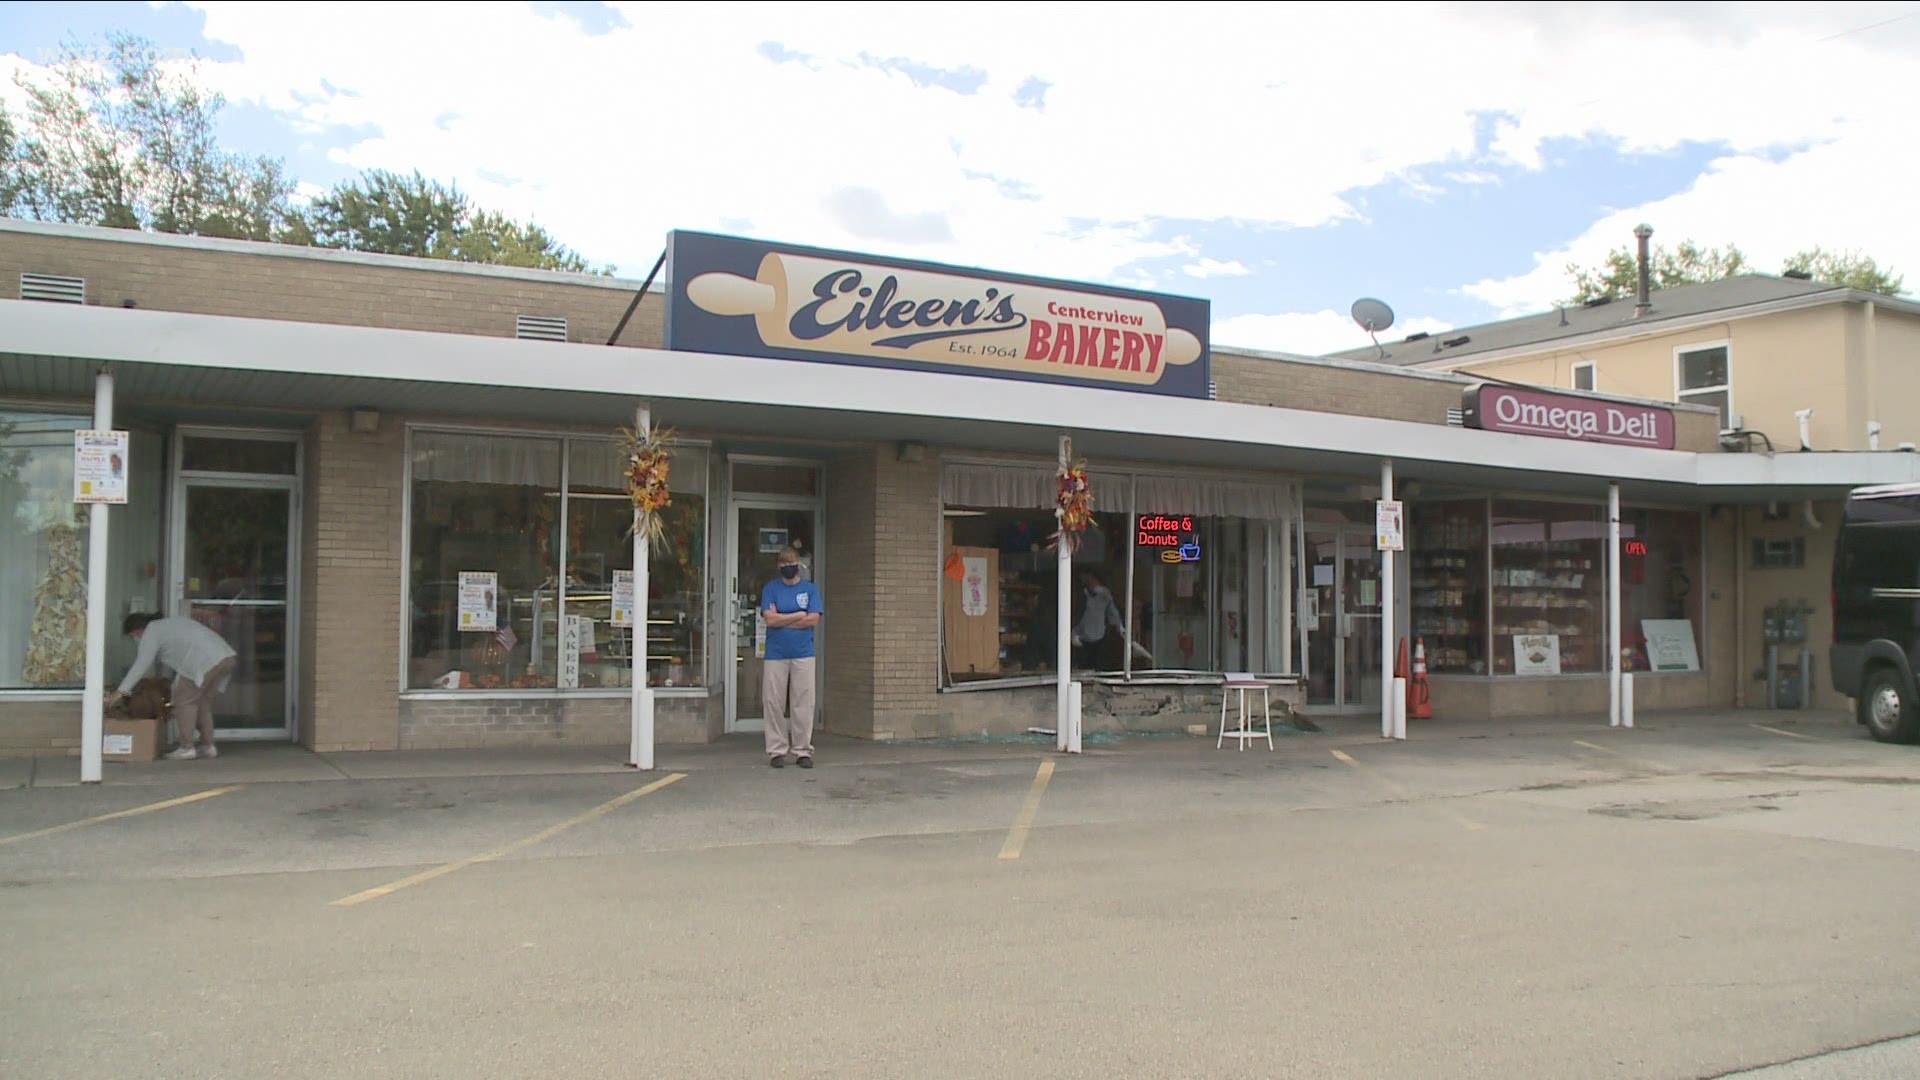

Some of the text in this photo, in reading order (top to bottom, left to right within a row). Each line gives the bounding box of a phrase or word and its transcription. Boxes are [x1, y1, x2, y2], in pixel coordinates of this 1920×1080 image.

[788, 269, 1027, 341] Eileen's
[1047, 301, 1144, 327] Centerview
[948, 340, 1018, 359] Est. 1964
[1024, 319, 1164, 374] BAKERY
[1495, 395, 1658, 439] Omega Deli
[1139, 515, 1193, 531] Coffee &
[1138, 532, 1178, 546] Donuts
[1625, 541, 1647, 556] OPEN
[565, 617, 577, 687] BAKERY
